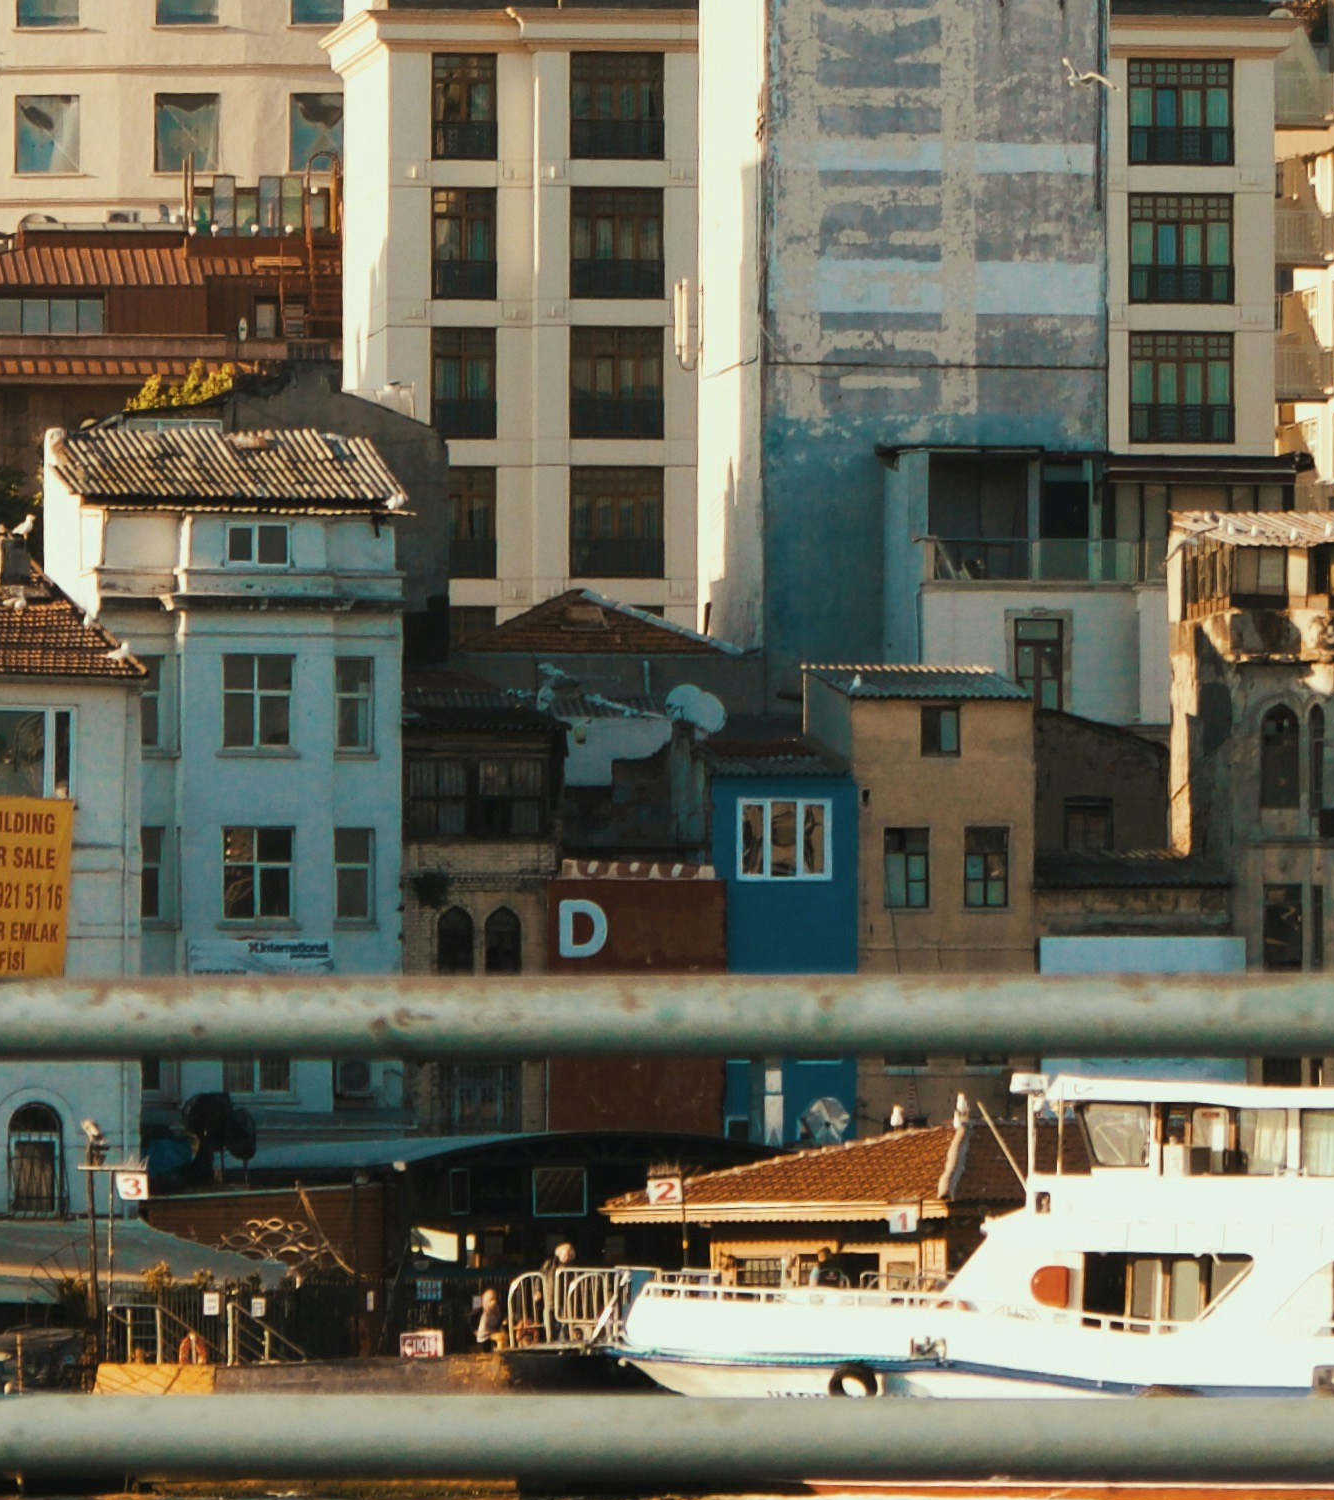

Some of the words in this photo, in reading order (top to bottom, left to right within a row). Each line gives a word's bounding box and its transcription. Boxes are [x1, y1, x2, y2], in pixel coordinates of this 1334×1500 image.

[13, 847, 56, 870] SALE
[25, 883, 42, 910] 51
[47, 884, 62, 911] 16
[10, 922, 58, 943] EMLAK
[123, 1177, 142, 1197] 3
[656, 1182, 676, 1200] 2
[898, 1212, 907, 1231] 1
